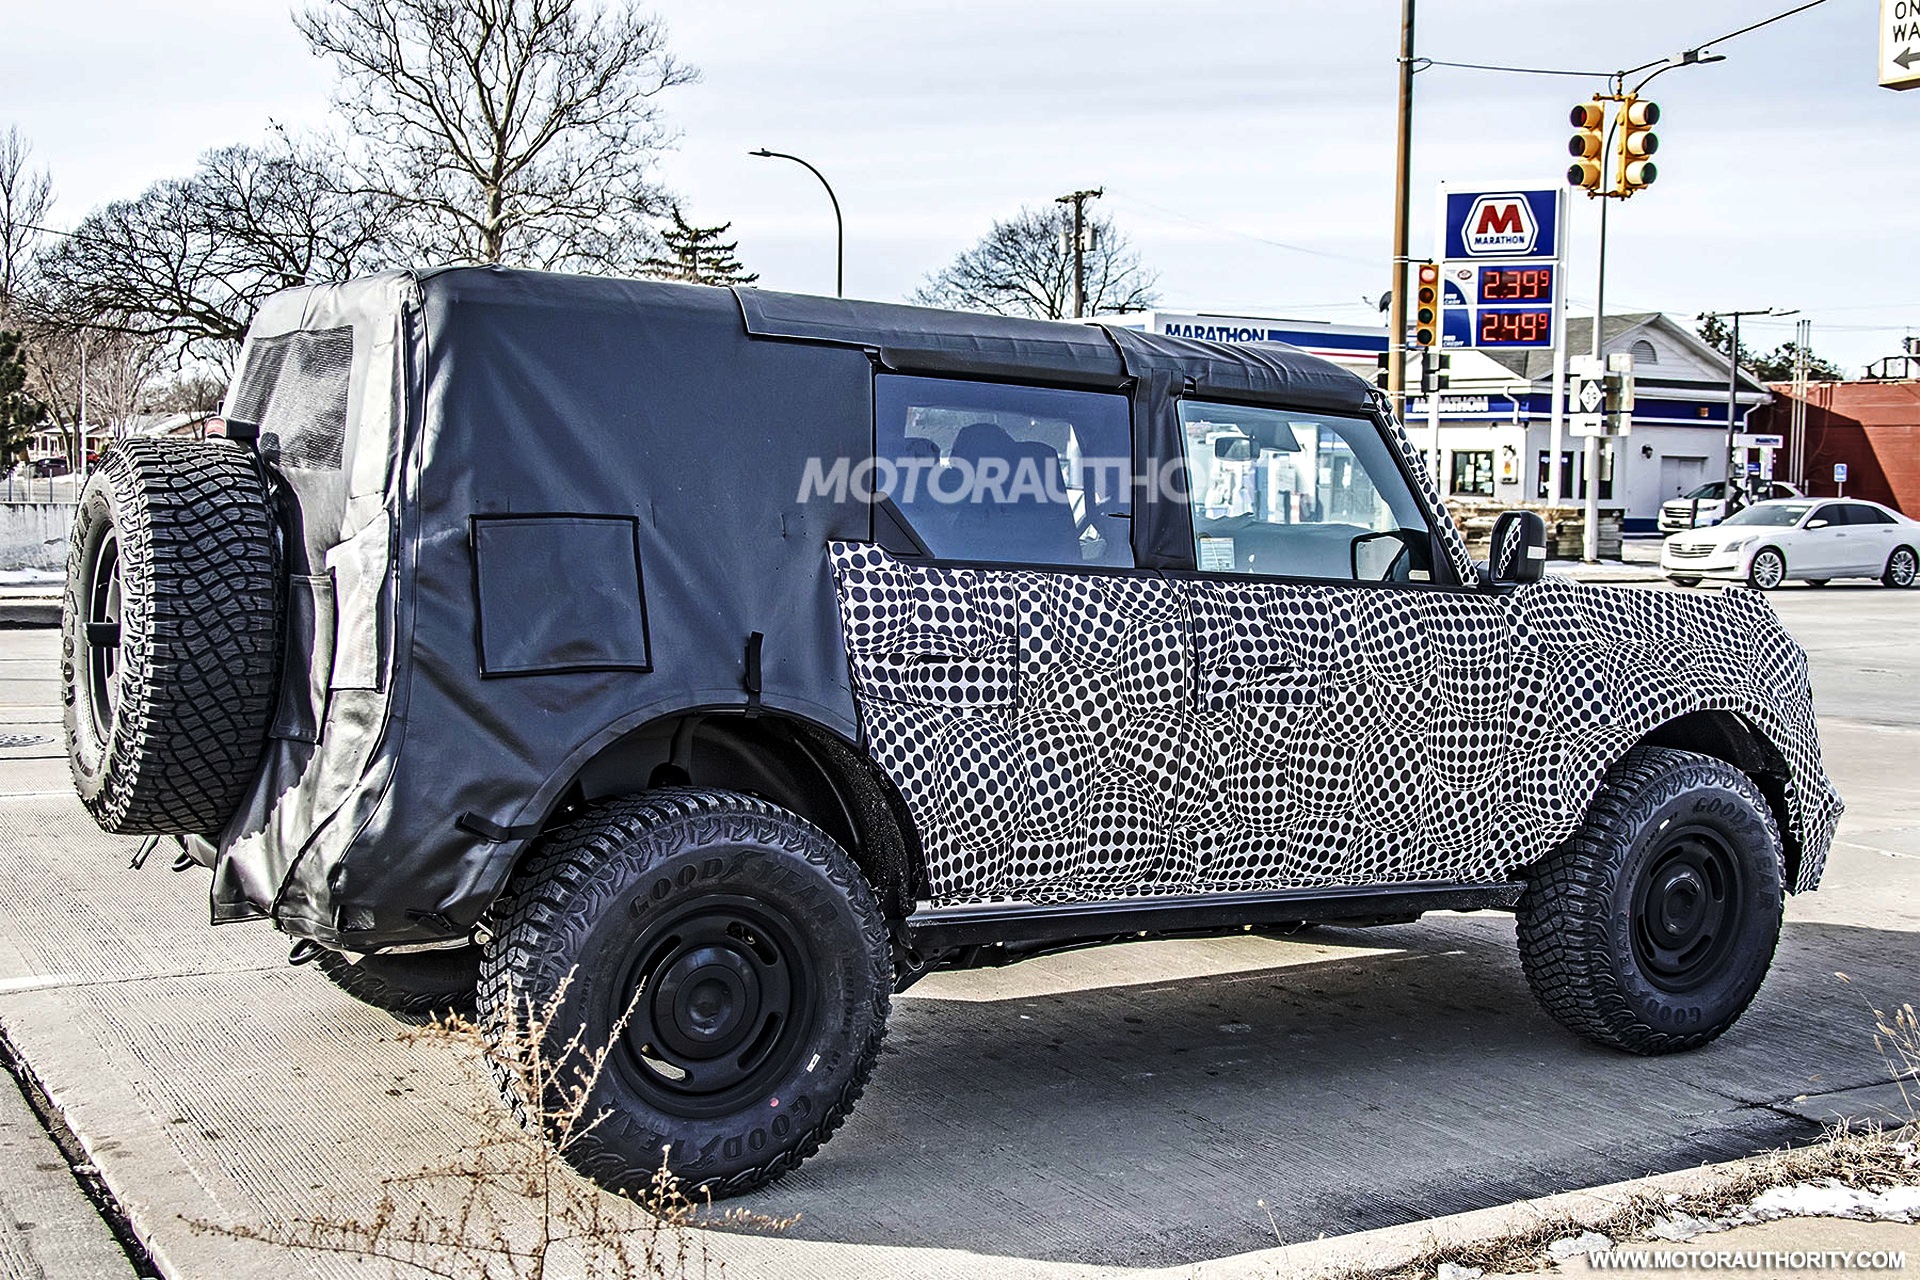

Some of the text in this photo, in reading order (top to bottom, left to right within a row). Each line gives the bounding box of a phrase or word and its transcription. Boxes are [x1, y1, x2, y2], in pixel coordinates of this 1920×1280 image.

[1476, 204, 1524, 235] M
[1474, 236, 1525, 245] MARATHON
[1165, 324, 1265, 342] MARATHON
[1412, 396, 1489, 413] MAATHON
[628, 849, 840, 926] GOODYEAR
[600, 1095, 813, 1170] GOODYEAR
